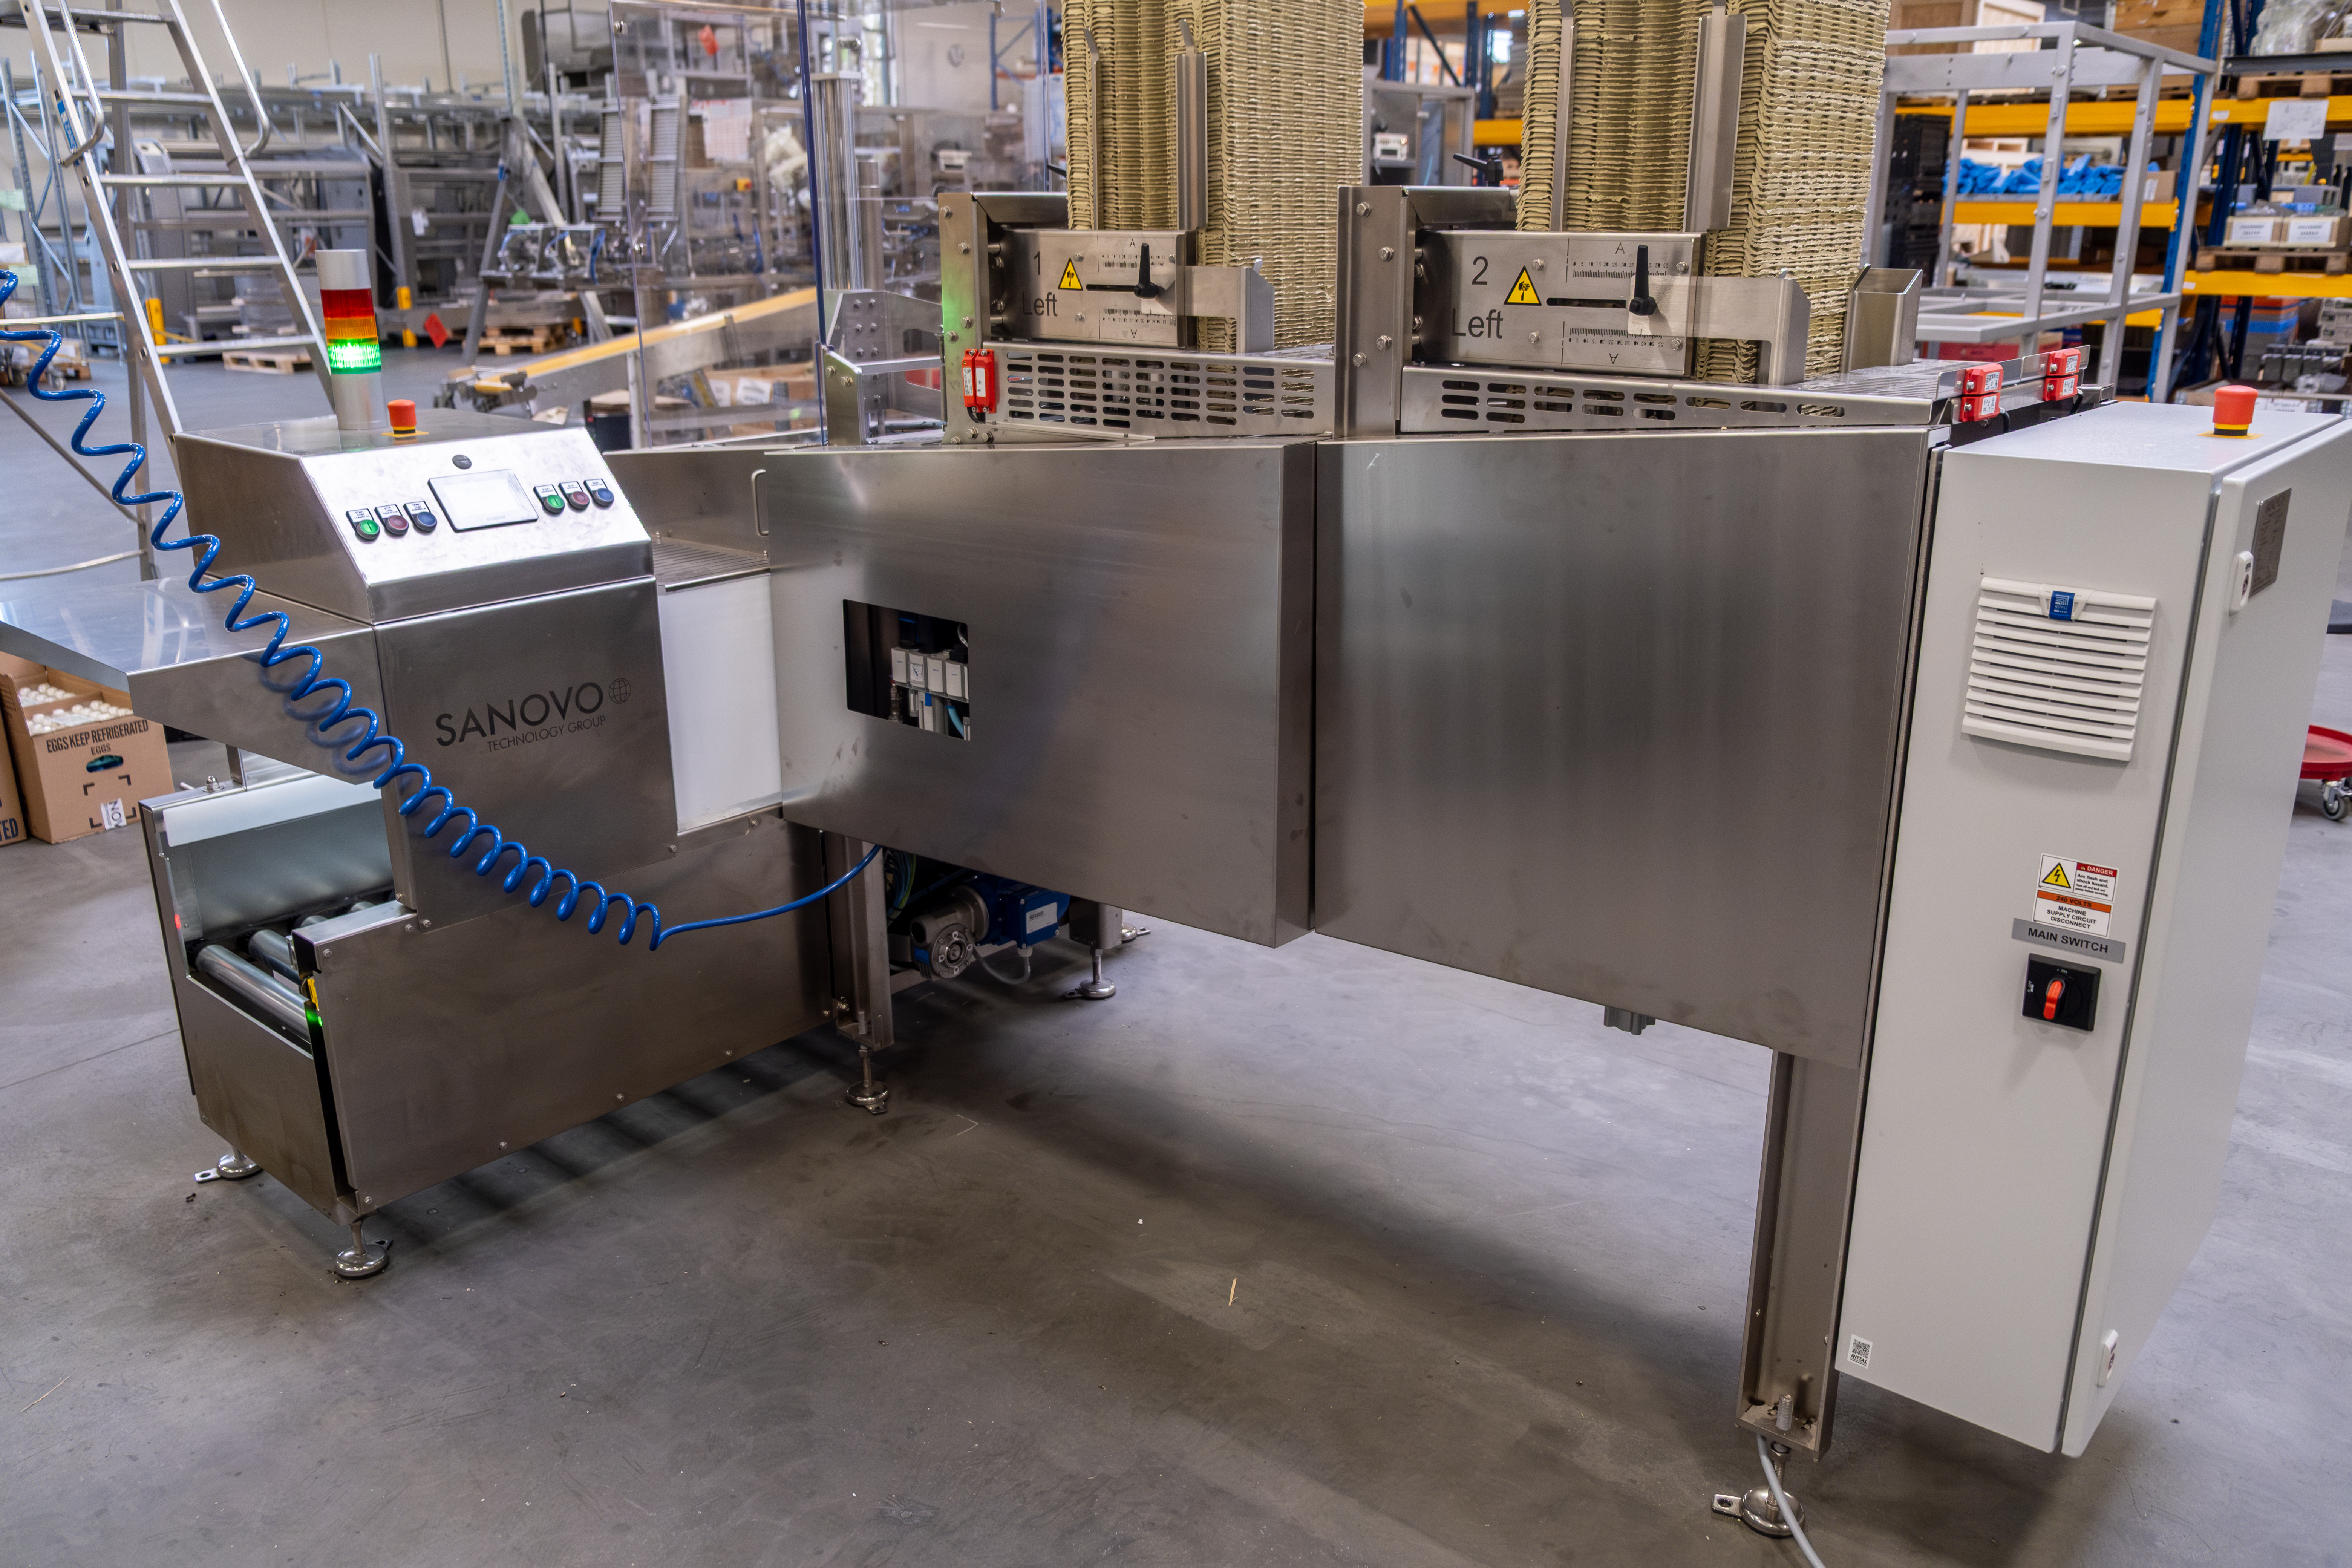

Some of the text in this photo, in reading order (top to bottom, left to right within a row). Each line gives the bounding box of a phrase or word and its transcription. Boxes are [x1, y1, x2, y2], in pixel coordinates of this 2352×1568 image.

[1129, 238, 1136, 248] A
[1615, 242, 1625, 254] A
[1034, 251, 1040, 276] 1
[1472, 256, 1488, 285] 2
[1022, 292, 1058, 317] Left
[1452, 308, 1504, 339] Left
[436, 682, 603, 747] SANOVO
[46, 719, 149, 753] EGGS KEEP REFRIGERATED
[487, 715, 606, 752] TECHNOLOGY GROUP
[91, 743, 111, 756] EGGS
[2087, 866, 2113, 876] DANGER
[2058, 905, 2087, 916] MACHINE
[2070, 899, 2092, 908] VOLTS
[2047, 909, 2096, 924] SUPPLY CIRCUIT
[2051, 916, 2091, 929] DISCONNECT
[2028, 927, 2108, 953] MAIN SWITCH
[1851, 1354, 1867, 1364] RITTAL
